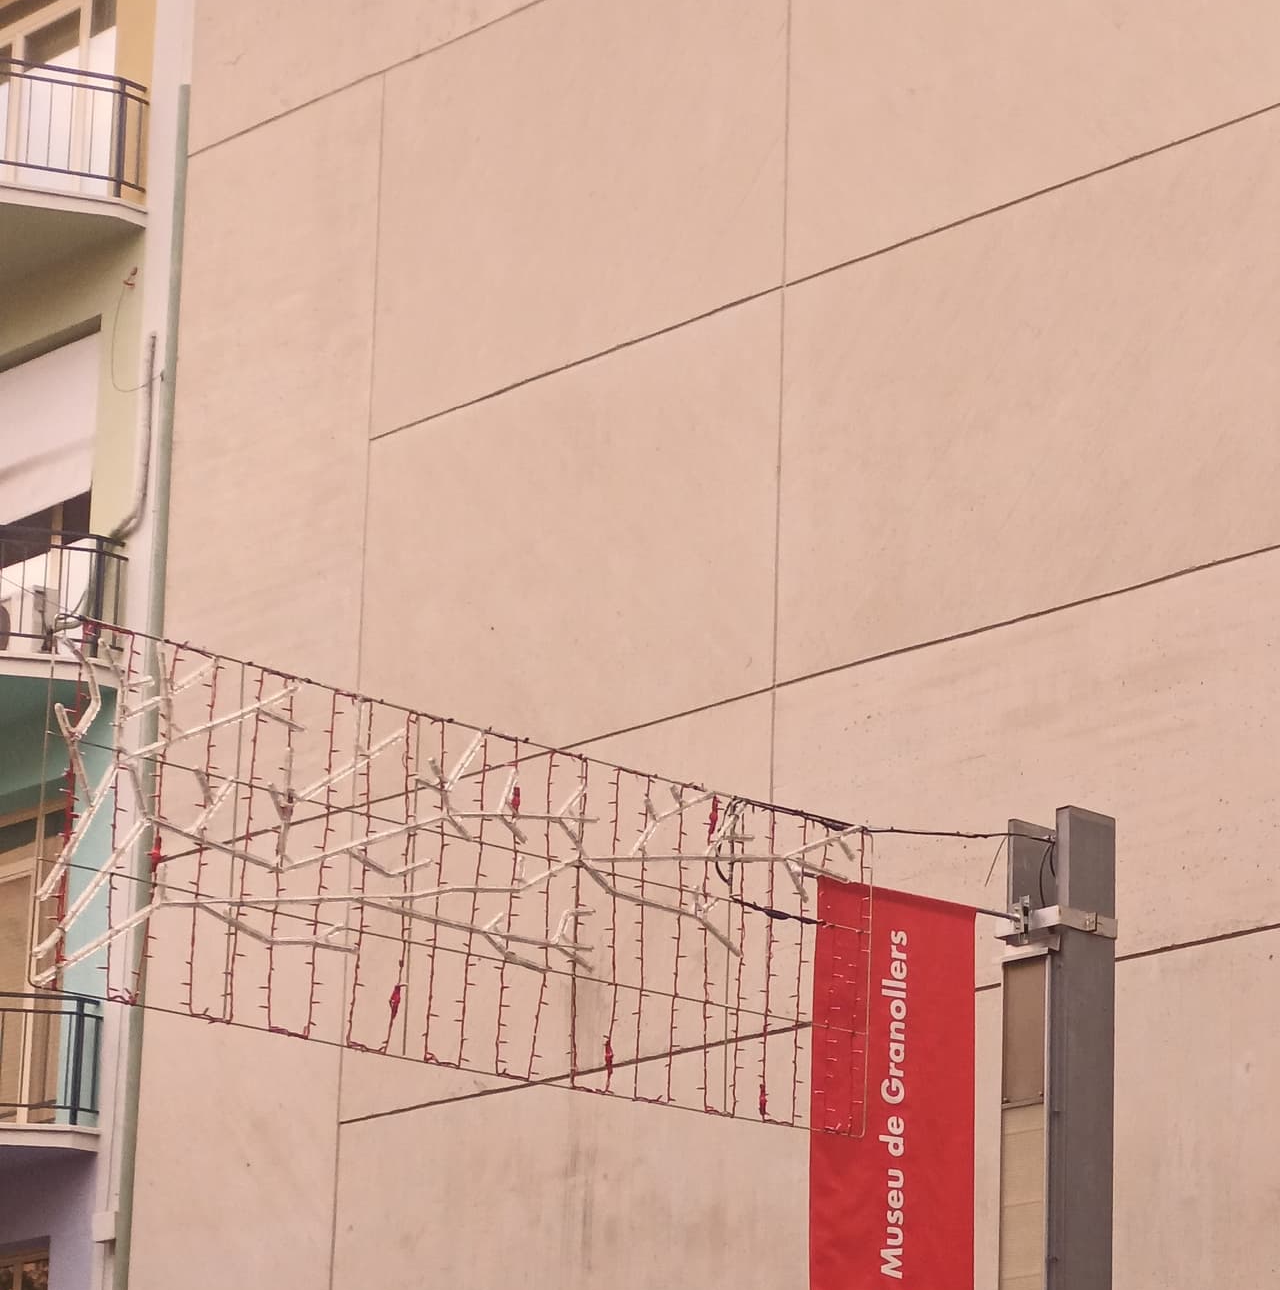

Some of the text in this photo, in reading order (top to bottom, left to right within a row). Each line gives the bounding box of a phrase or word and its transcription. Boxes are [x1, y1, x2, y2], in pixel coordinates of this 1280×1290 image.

[878, 929, 909, 1279] Museu de Granollers
